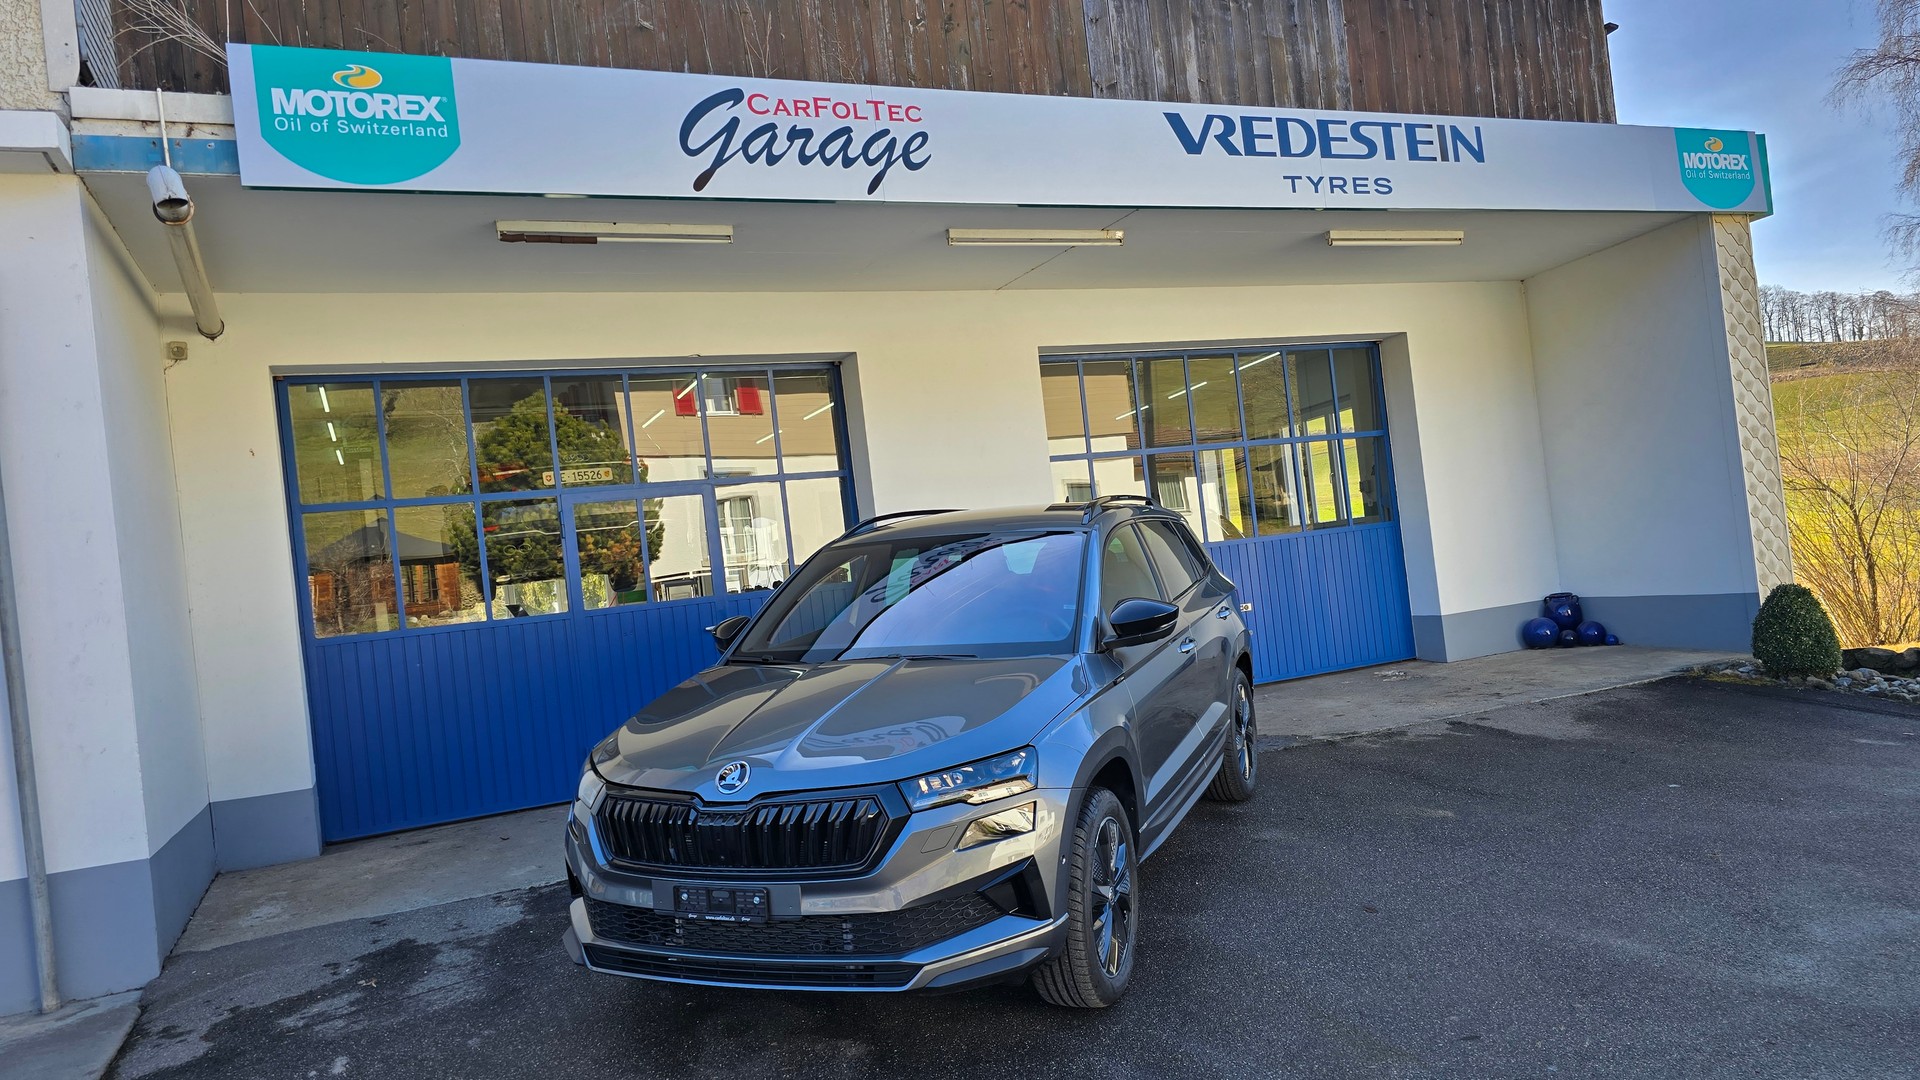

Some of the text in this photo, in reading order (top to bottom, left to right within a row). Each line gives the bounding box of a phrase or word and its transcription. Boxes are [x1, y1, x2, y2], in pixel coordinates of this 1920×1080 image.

[271, 87, 444, 122] MOTOREX
[274, 116, 449, 138] Oil of Switzerland
[1162, 112, 1485, 163] VREDESTEIN
[679, 87, 932, 195] Garage
[1683, 152, 1748, 170] MOTOREX
[1283, 175, 1393, 195] TYRES
[1685, 169, 1750, 180] Oil of Switzerland
[572, 470, 602, 481] 15526
